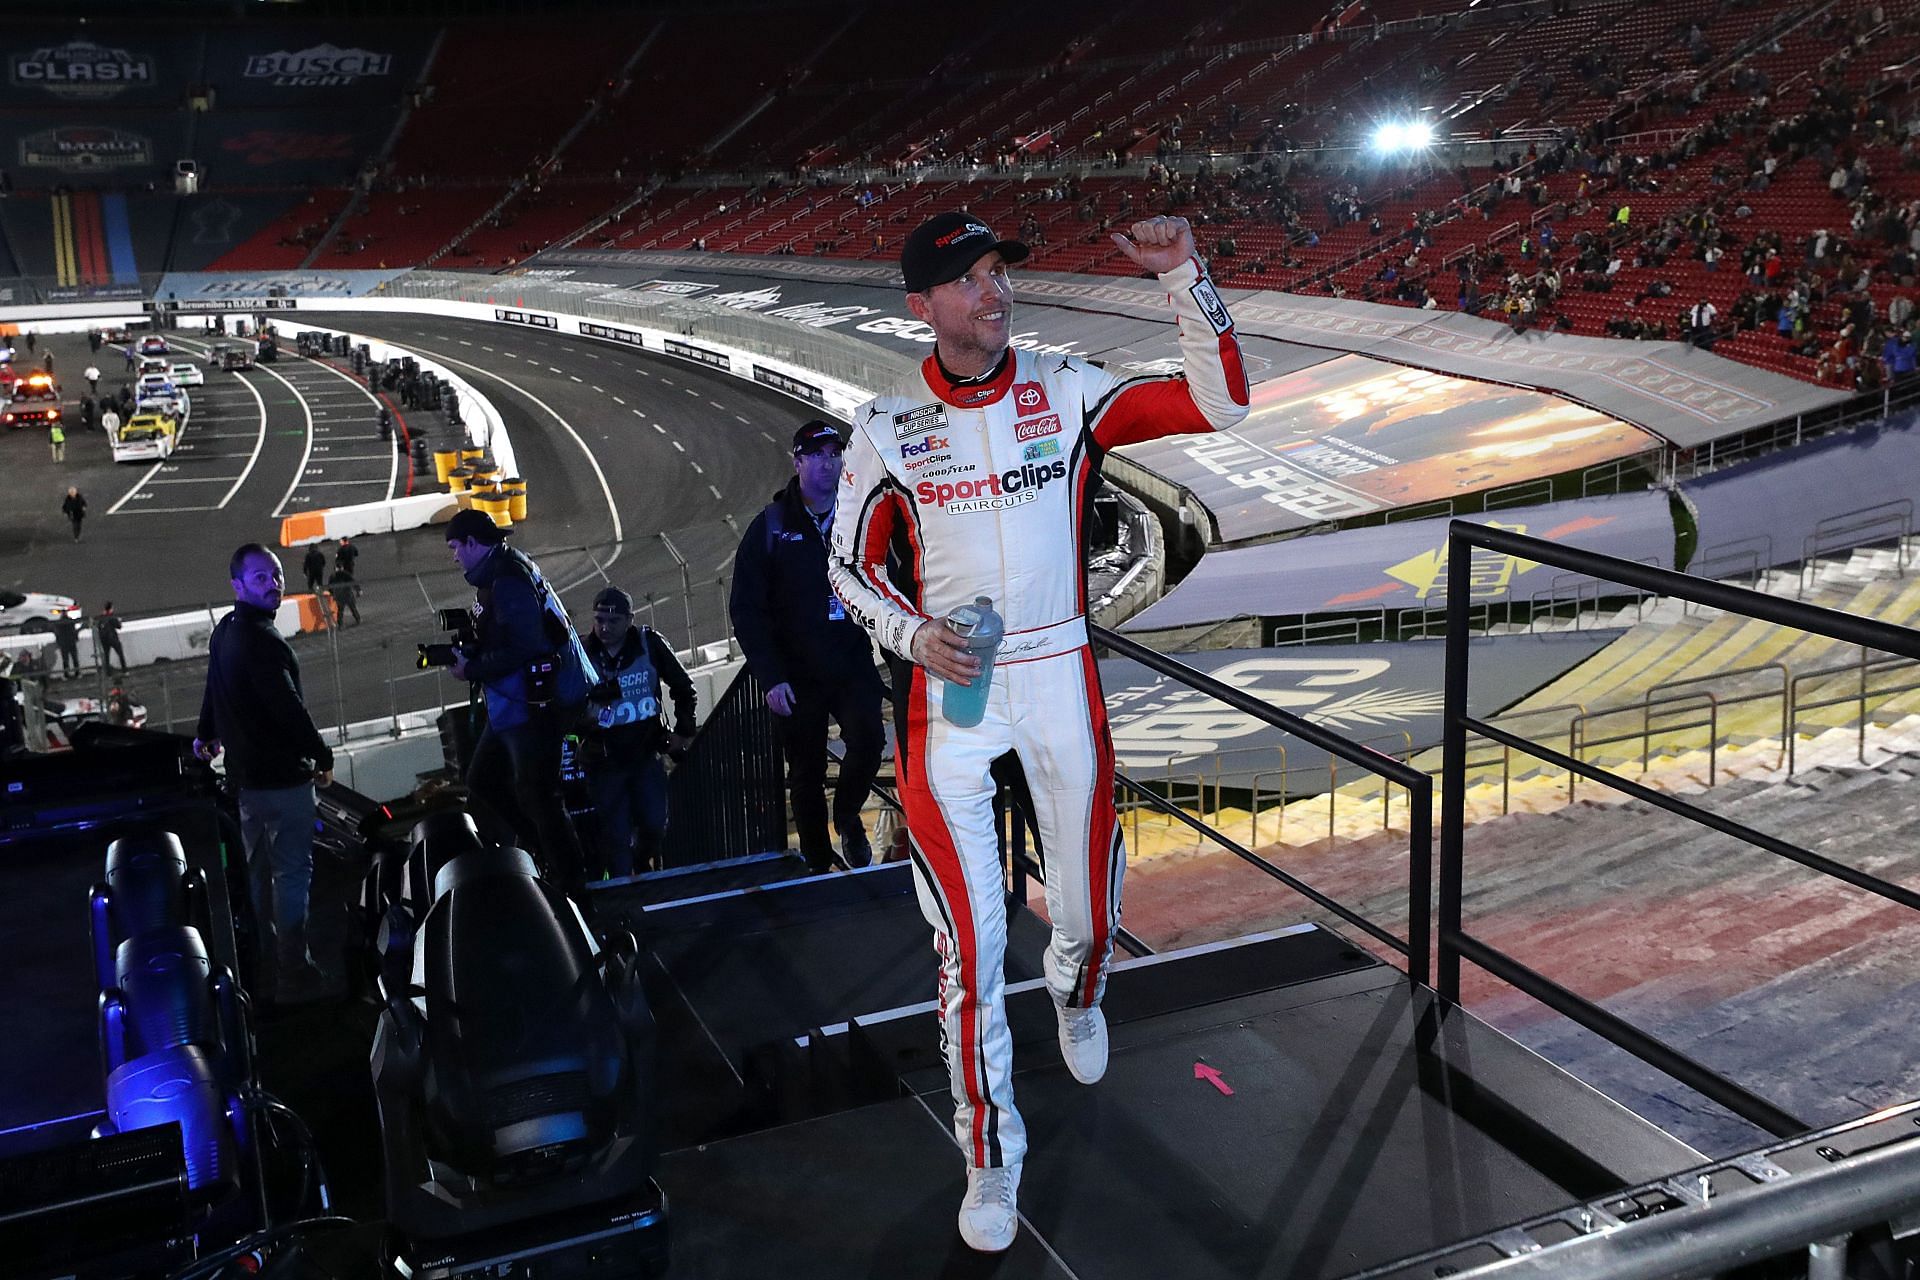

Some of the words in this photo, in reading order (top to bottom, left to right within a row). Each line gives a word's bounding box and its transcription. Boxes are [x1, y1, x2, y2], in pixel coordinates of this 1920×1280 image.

[18, 61, 148, 80] CLASH
[249, 55, 390, 75] BUSCH
[274, 76, 353, 87] LIGHT
[910, 406, 937, 420] NASCAR
[903, 423, 917, 432] CUP
[917, 416, 940, 428] SERIES
[1017, 415, 1058, 440] Coca-Cola
[901, 435, 950, 459] FedEx
[904, 454, 952, 471] SportClips
[916, 460, 1067, 507] SportClips
[1172, 430, 1264, 475] FULL
[1226, 465, 1381, 520] SPEED
[950, 491, 1035, 513] HAIRCUTS
[617, 671, 649, 688] SCAR
[421, 1256, 456, 1270] Martin
